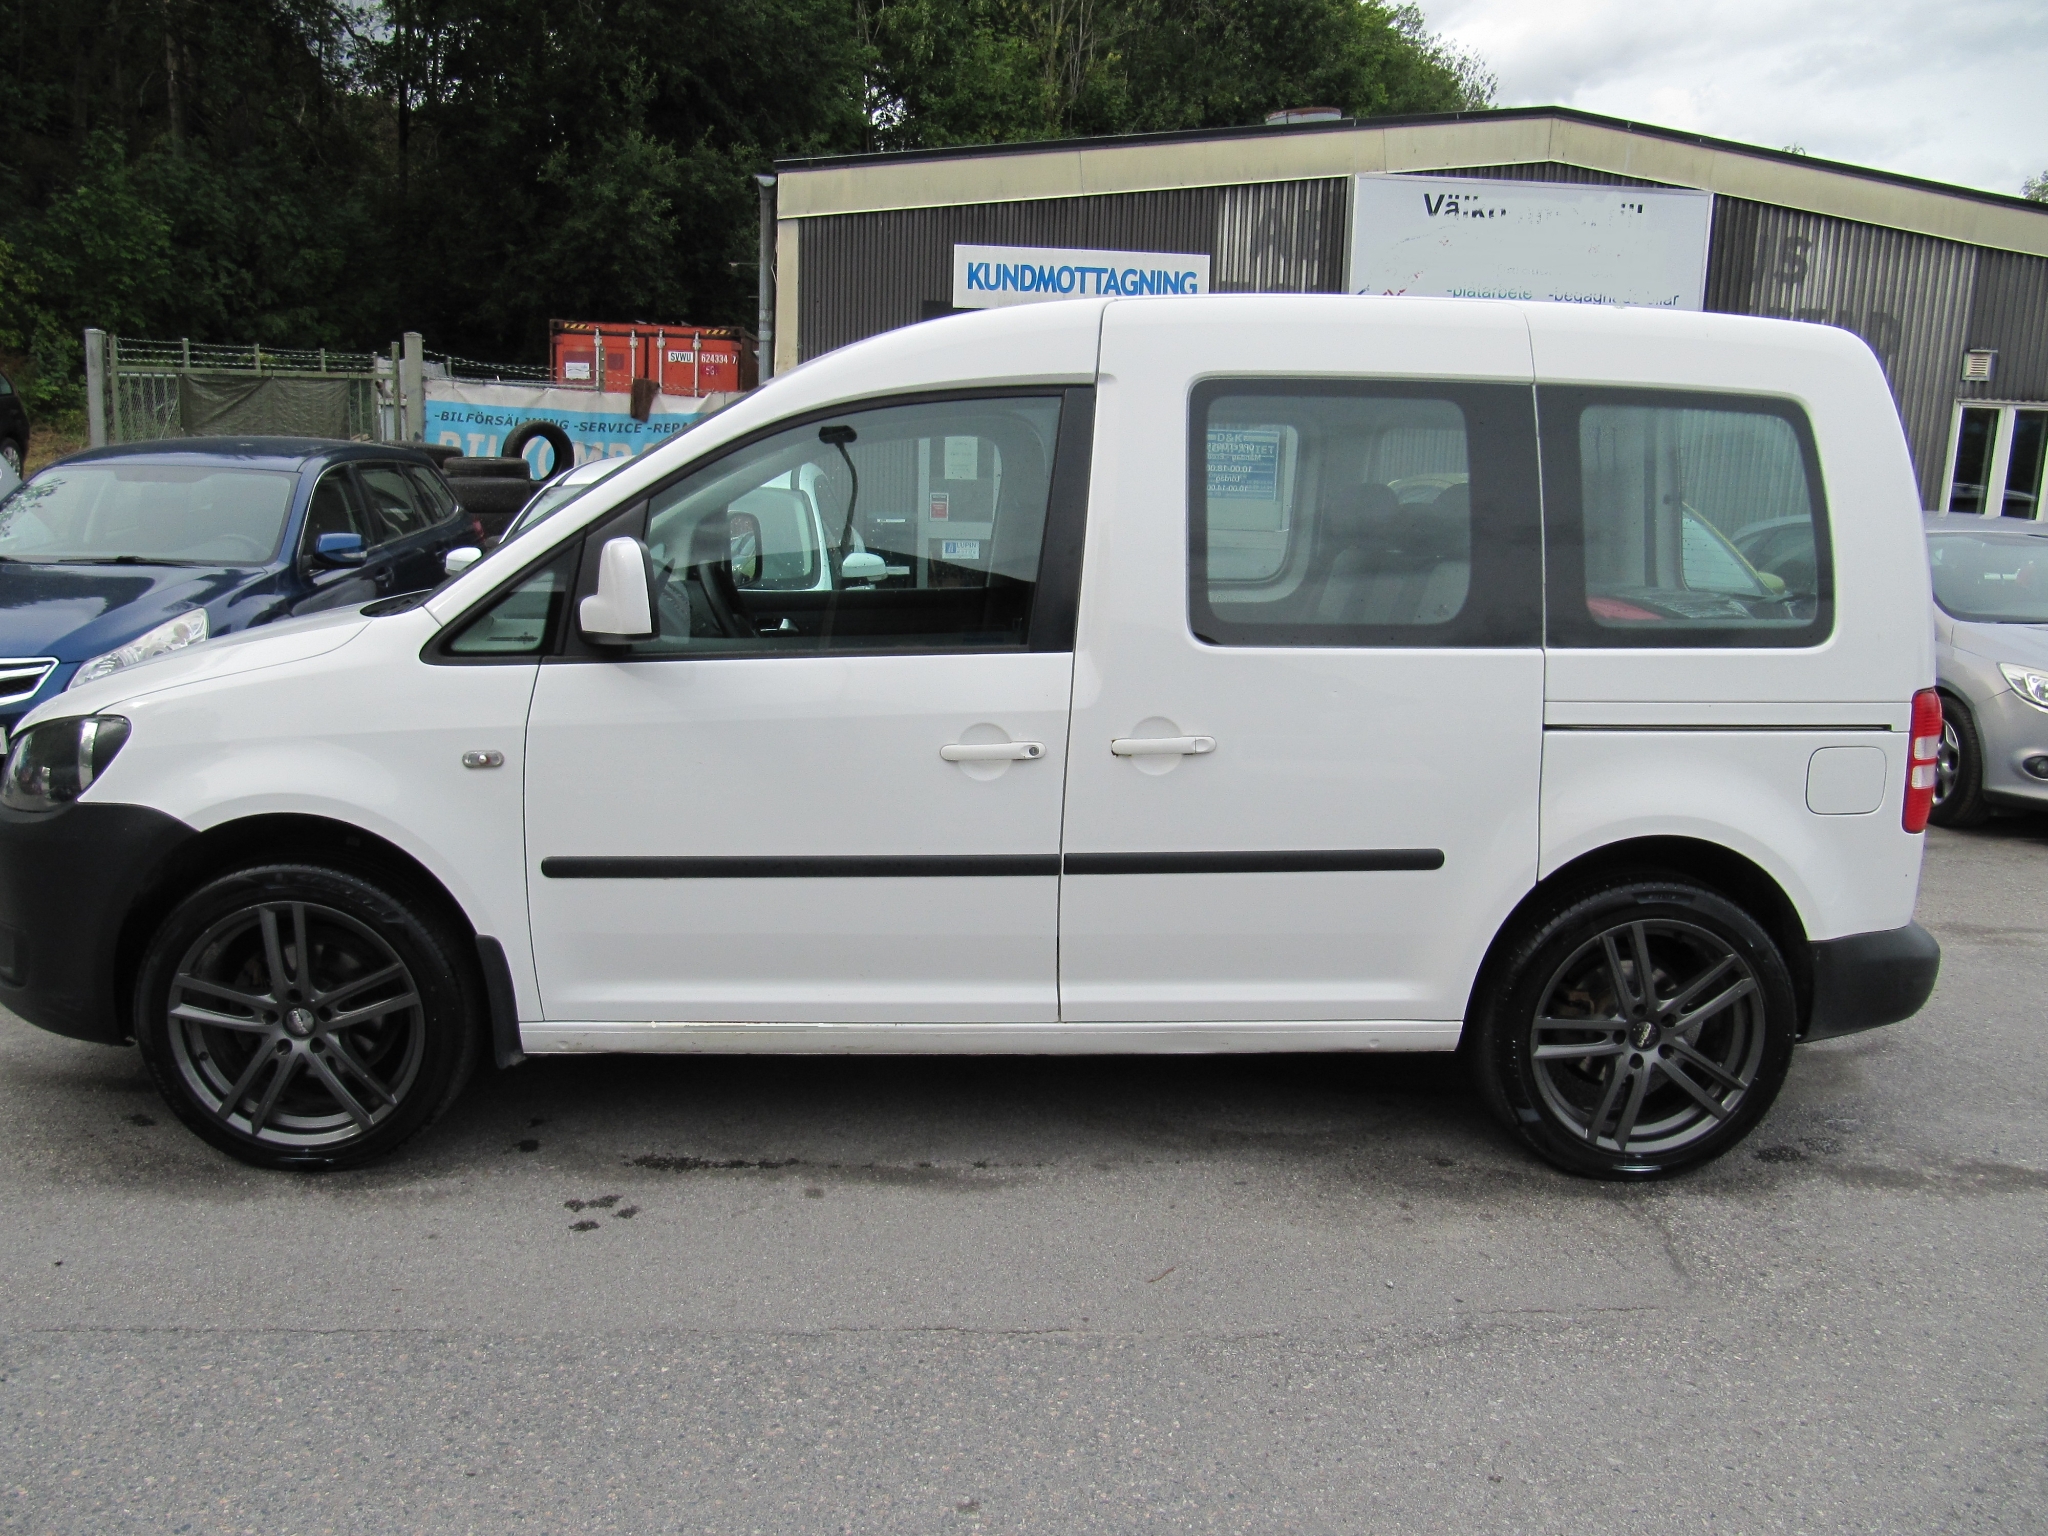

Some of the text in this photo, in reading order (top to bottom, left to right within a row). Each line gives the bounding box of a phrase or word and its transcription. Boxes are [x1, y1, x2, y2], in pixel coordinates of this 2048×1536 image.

[967, 262, 1198, 296] KUNDMOTTAGNING
[670, 352, 692, 362] SVWU
[701, 353, 728, 364] 624334
[574, 421, 642, 434] -SERVICE
